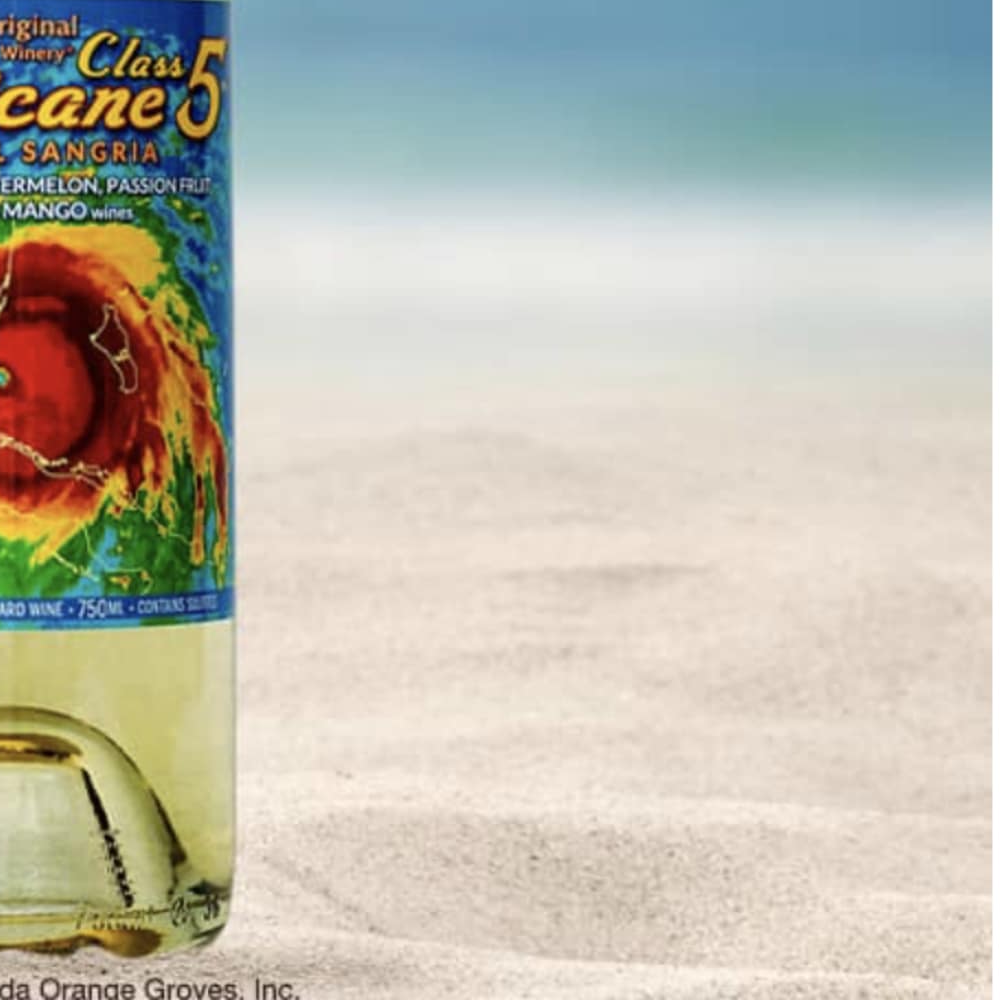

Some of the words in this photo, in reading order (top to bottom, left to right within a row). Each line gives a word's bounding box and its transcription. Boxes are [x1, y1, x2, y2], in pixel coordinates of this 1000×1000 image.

[78, 31, 186, 79] Class
[176, 37, 229, 140] 5
[22, 140, 159, 163] SANGRIA
[106, 177, 177, 194] PASSION
[3, 202, 87, 220] MANGO
[91, 204, 134, 220] wines
[29, 600, 63, 617] WINE
